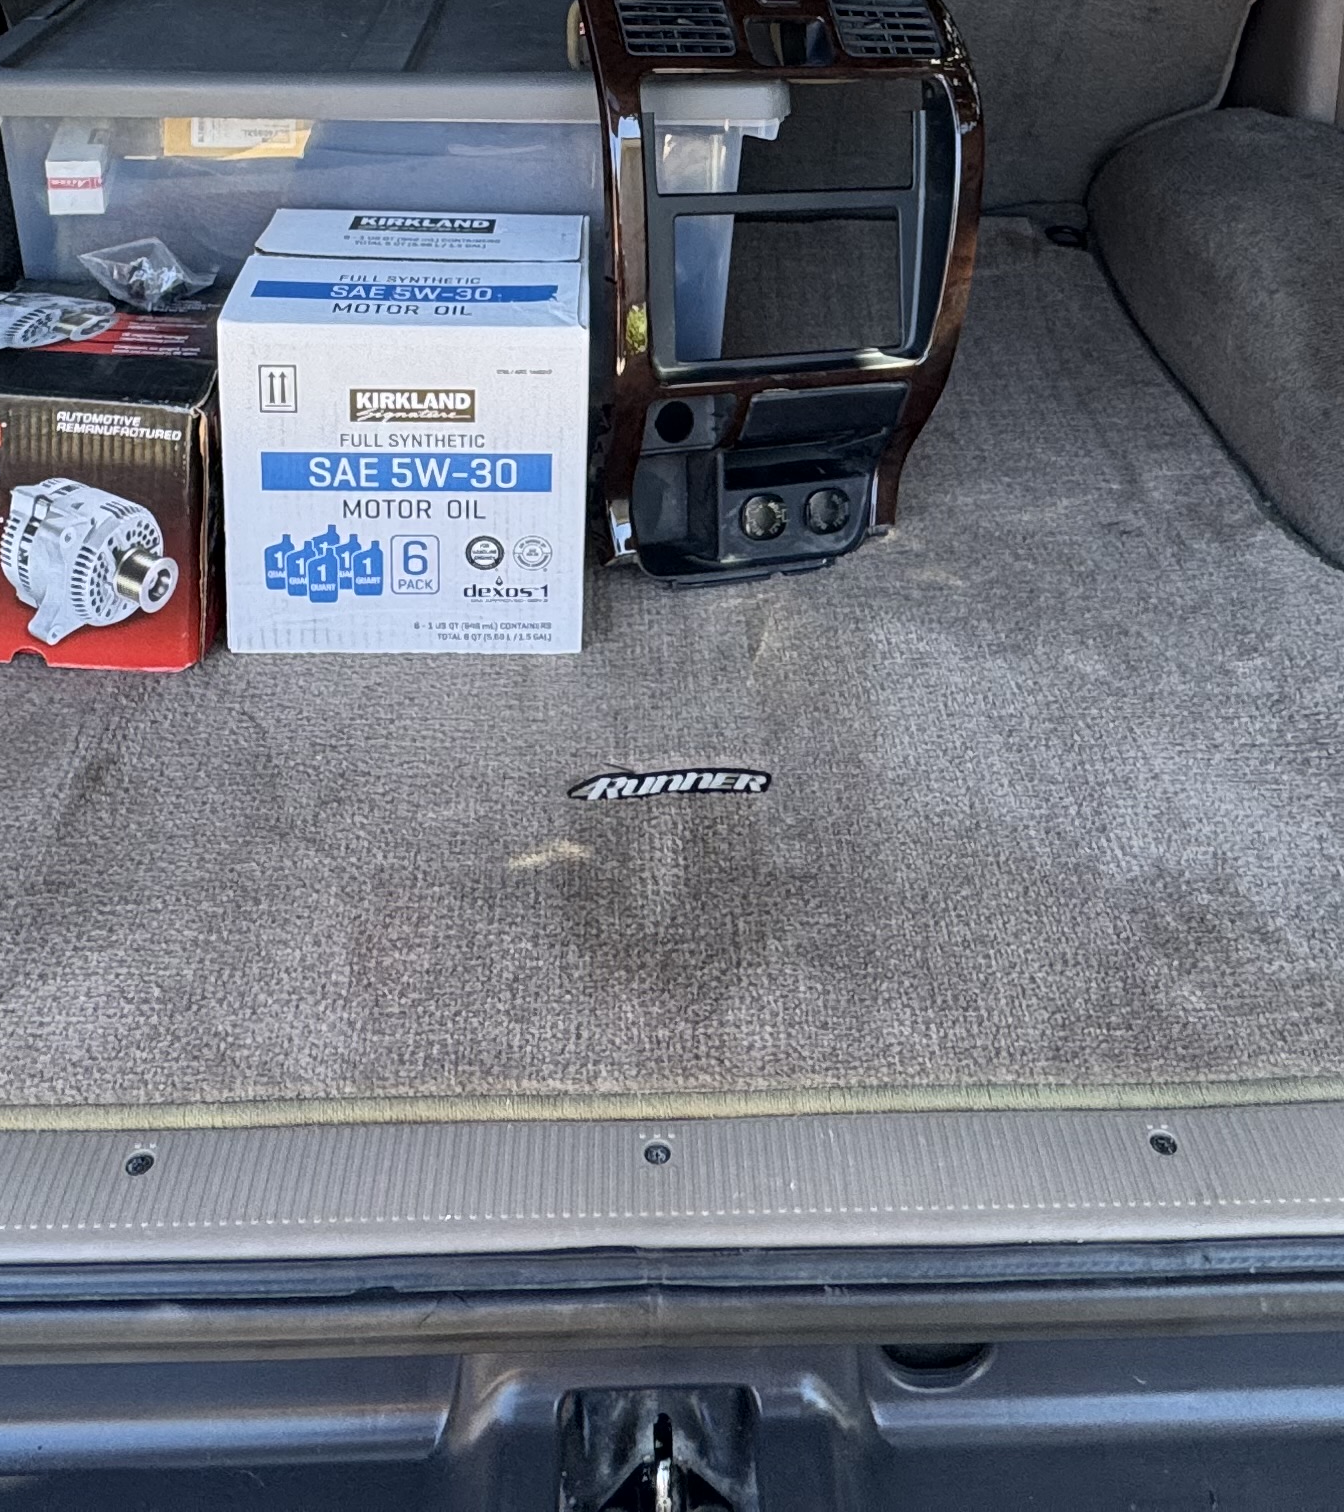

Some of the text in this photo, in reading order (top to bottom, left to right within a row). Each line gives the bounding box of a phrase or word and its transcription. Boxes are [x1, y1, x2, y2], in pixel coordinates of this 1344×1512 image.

[359, 216, 490, 229] KIRKLAND
[339, 274, 481, 285] FULL SYNTHETIC
[330, 285, 493, 301] SAE 5W-30
[332, 303, 472, 317] MOTOR OIL
[356, 392, 472, 410] KIRKLAND
[56, 410, 142, 428] AUTOMOTIVE
[356, 408, 471, 424] Signature
[56, 421, 182, 442] REMANUFACTURED
[340, 433, 486, 449] FULL SYNTHETIC
[309, 456, 518, 489] SAE 5W-30
[342, 499, 487, 520] MOTOR OIL
[274, 550, 284, 569] 1
[295, 557, 305, 576] 1
[341, 550, 350, 569] 1
[362, 557, 372, 575] 1
[403, 540, 428, 576] 6
[317, 563, 327, 582] 1
[355, 575, 381, 585] QUART
[310, 583, 336, 592] QUART
[398, 578, 434, 591] PACK
[448, 622, 459, 630] QT
[499, 621, 552, 631] CONTAINERS
[438, 632, 462, 641] TOTAL
[471, 633, 482, 641] QT
